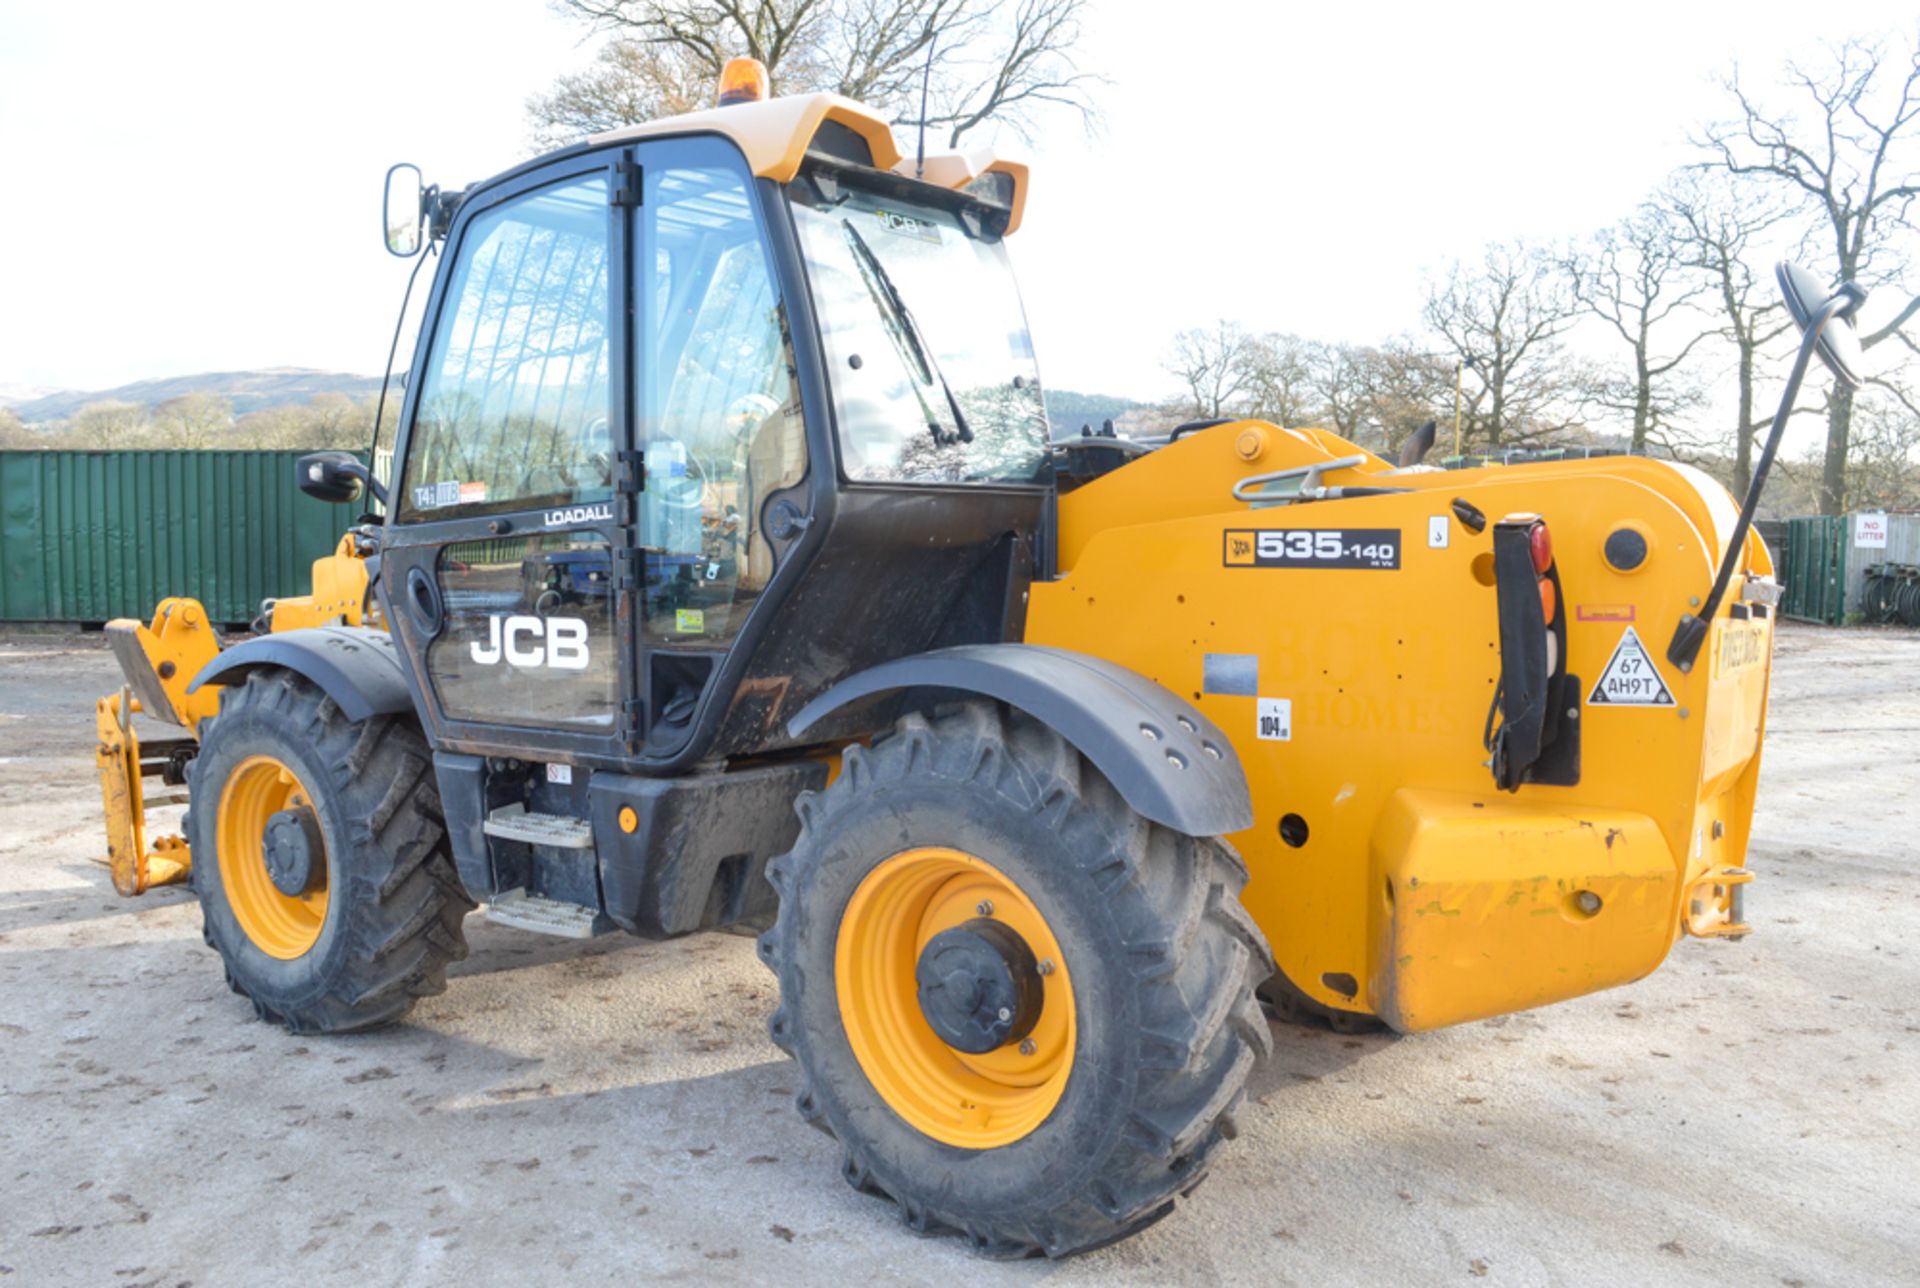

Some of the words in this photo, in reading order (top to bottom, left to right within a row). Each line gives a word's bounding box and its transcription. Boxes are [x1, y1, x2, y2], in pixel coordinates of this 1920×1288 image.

[544, 504, 613, 526] LOADALL
[1863, 521, 1879, 530] NO
[1856, 532, 1885, 541] LITTER
[470, 615, 589, 669] JCB
[1620, 658, 1642, 674] 67
[1607, 678, 1653, 694] AH9T
[1260, 716, 1280, 737] 104
